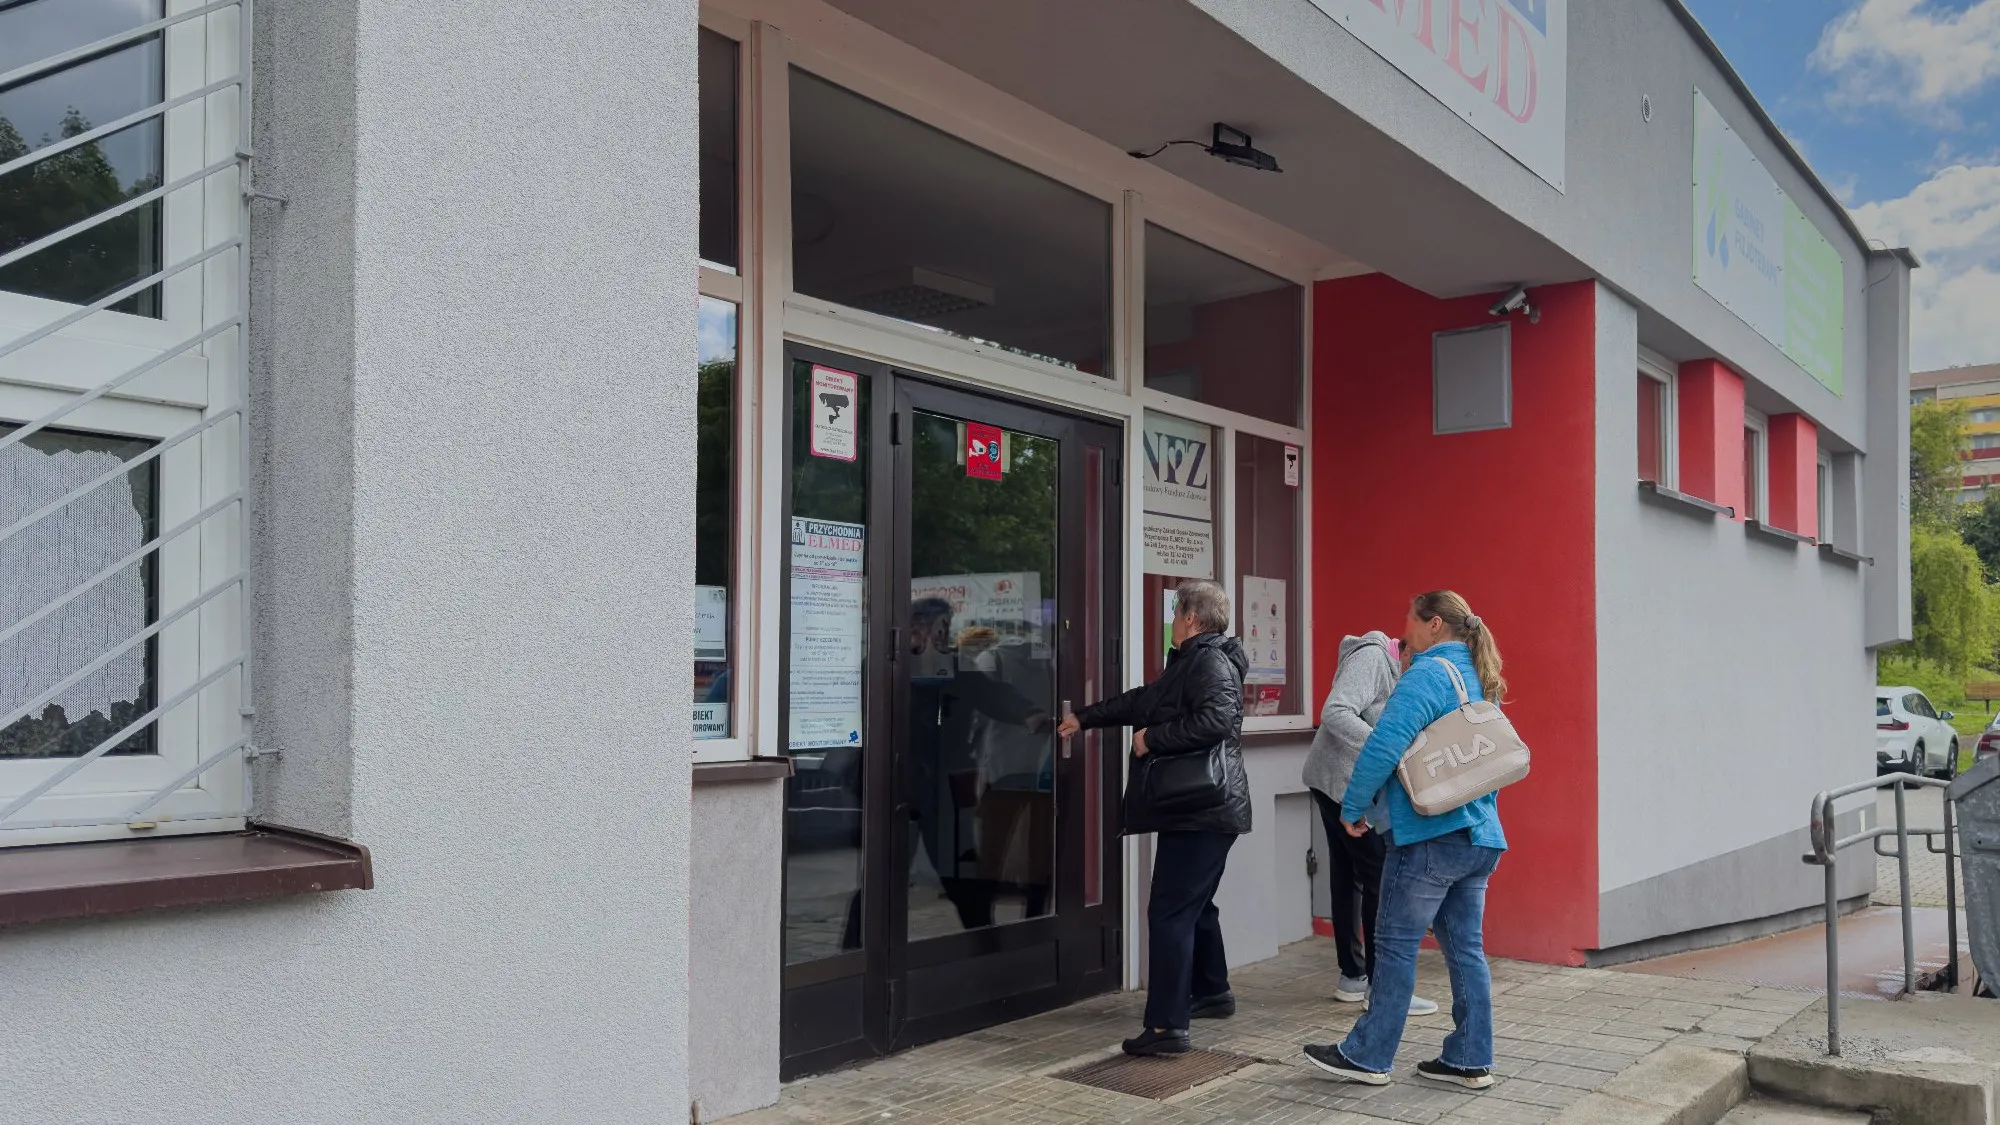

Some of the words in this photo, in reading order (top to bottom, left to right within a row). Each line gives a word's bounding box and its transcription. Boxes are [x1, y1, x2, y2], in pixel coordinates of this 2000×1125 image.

[1735, 198, 1764, 243] GABINET
[1143, 430, 1209, 490] NFZ
[808, 522, 861, 539] PRZYCHODNIA
[808, 535, 861, 552] ELMED
[1422, 733, 1498, 779] FILA
